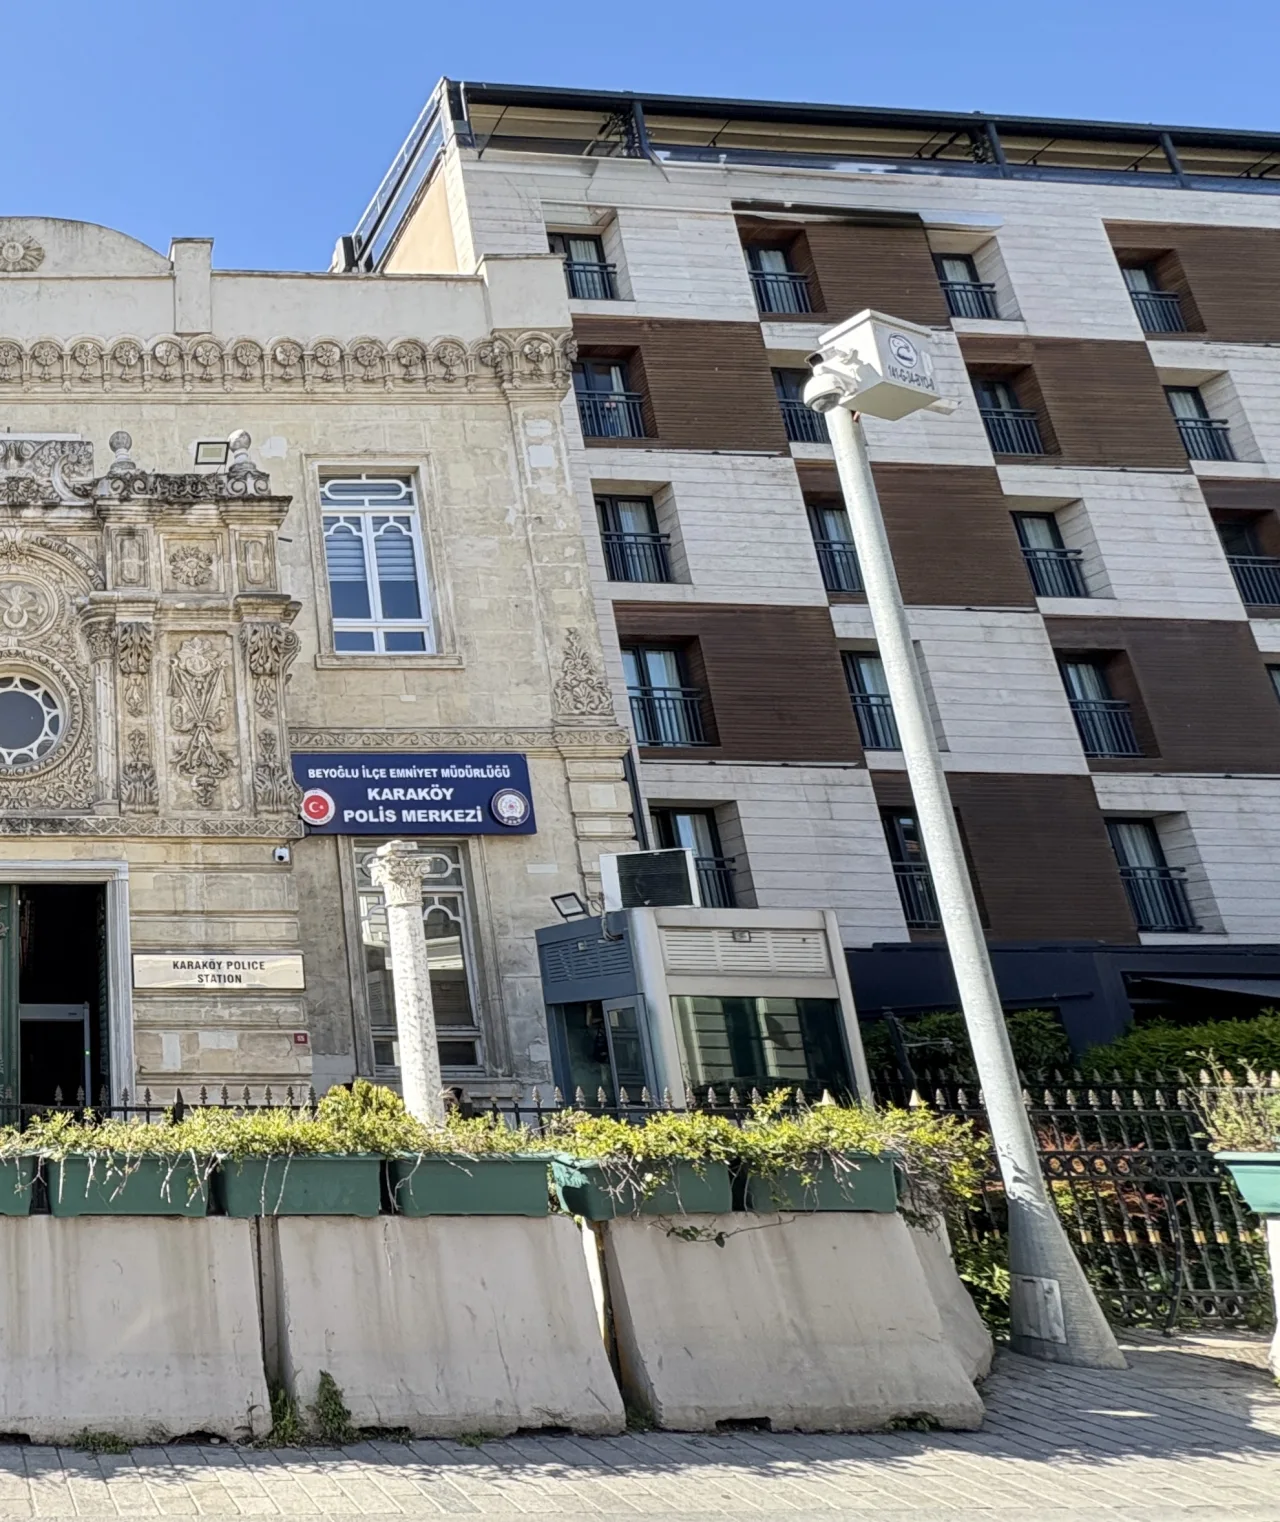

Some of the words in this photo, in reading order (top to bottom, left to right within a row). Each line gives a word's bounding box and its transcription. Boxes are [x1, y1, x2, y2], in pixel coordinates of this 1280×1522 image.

[308, 765, 359, 779] BEYOĞLU
[362, 765, 387, 780] İLÇE
[389, 765, 438, 779] EMNİYET
[441, 765, 511, 779] MÜDÜRLÜĞÜ
[367, 784, 454, 801] KARAKÖY
[343, 805, 397, 822] POLİS
[402, 806, 483, 823] MERKEZİ
[172, 958, 223, 970] KARAKÖY
[227, 961, 266, 971] POLICE
[197, 974, 242, 983] STATION
